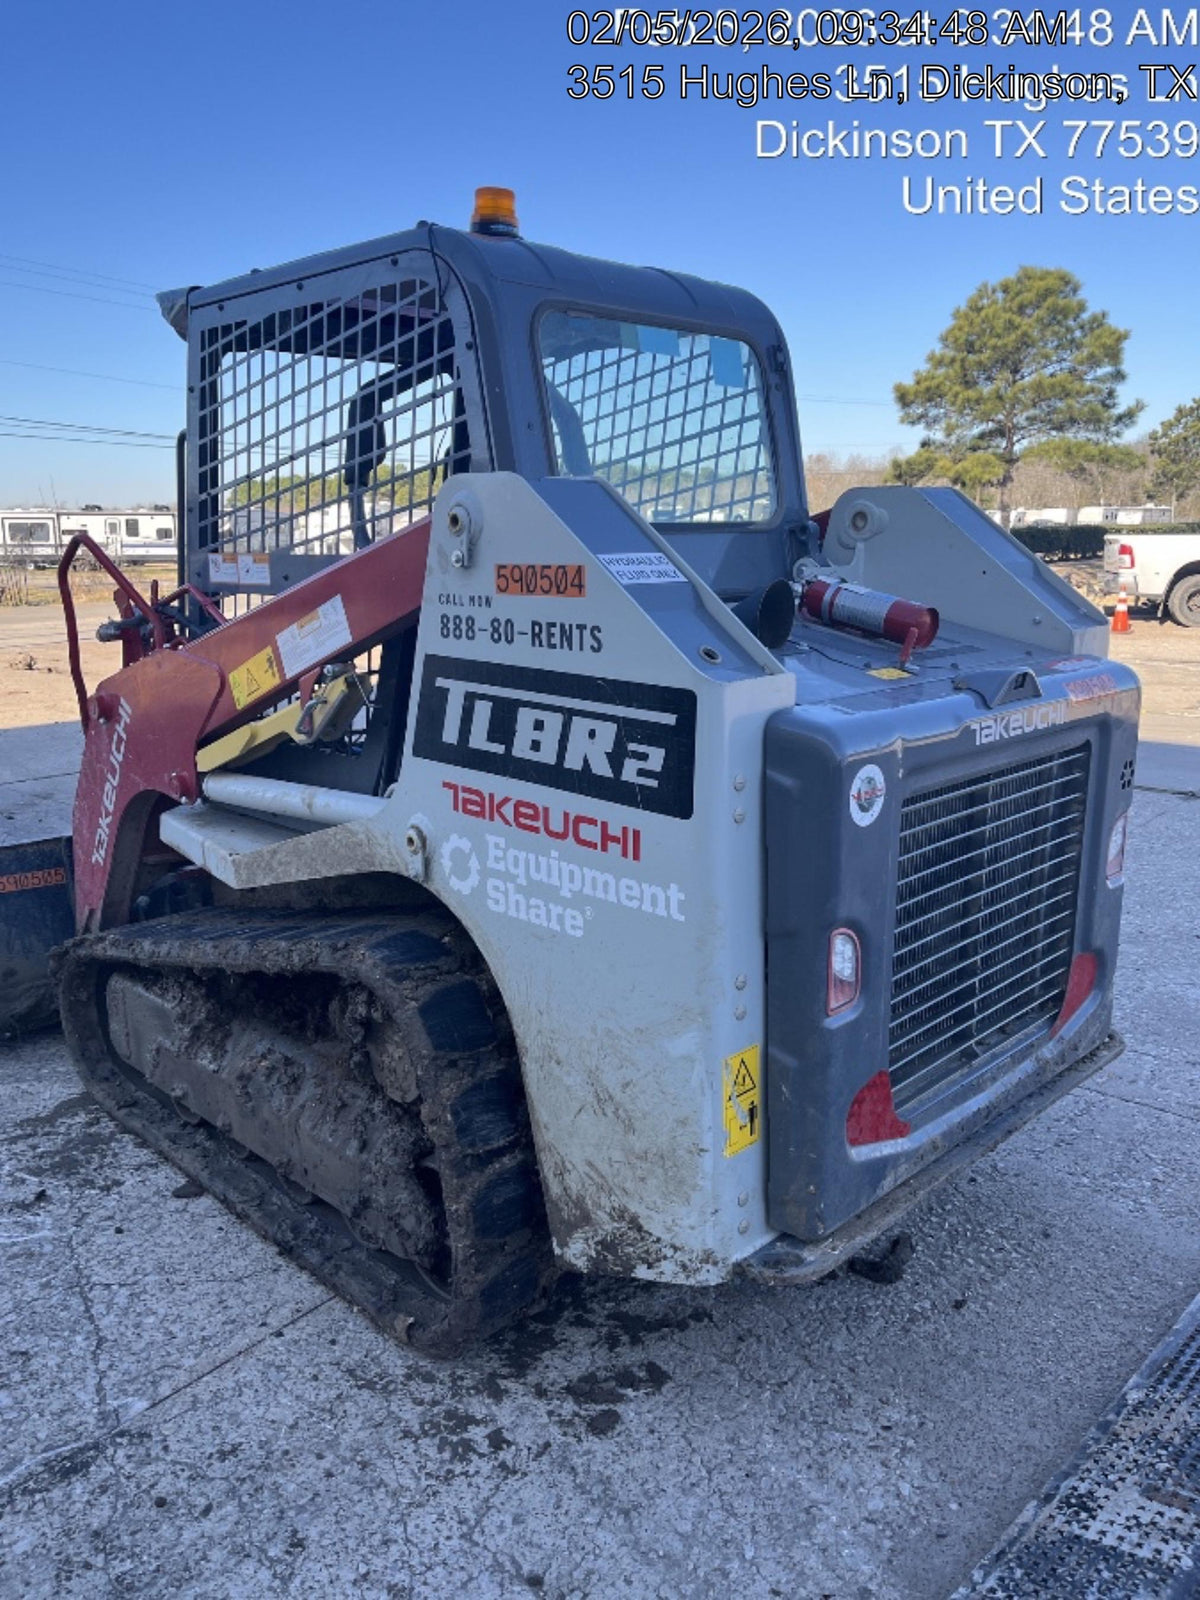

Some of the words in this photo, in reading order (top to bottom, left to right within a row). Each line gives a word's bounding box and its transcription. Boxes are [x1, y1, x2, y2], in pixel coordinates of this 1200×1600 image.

[497, 564, 584, 595] 590504
[438, 592, 465, 607] CALL
[440, 613, 604, 653] 888-80-RENTS
[486, 833, 686, 922] Equipment
